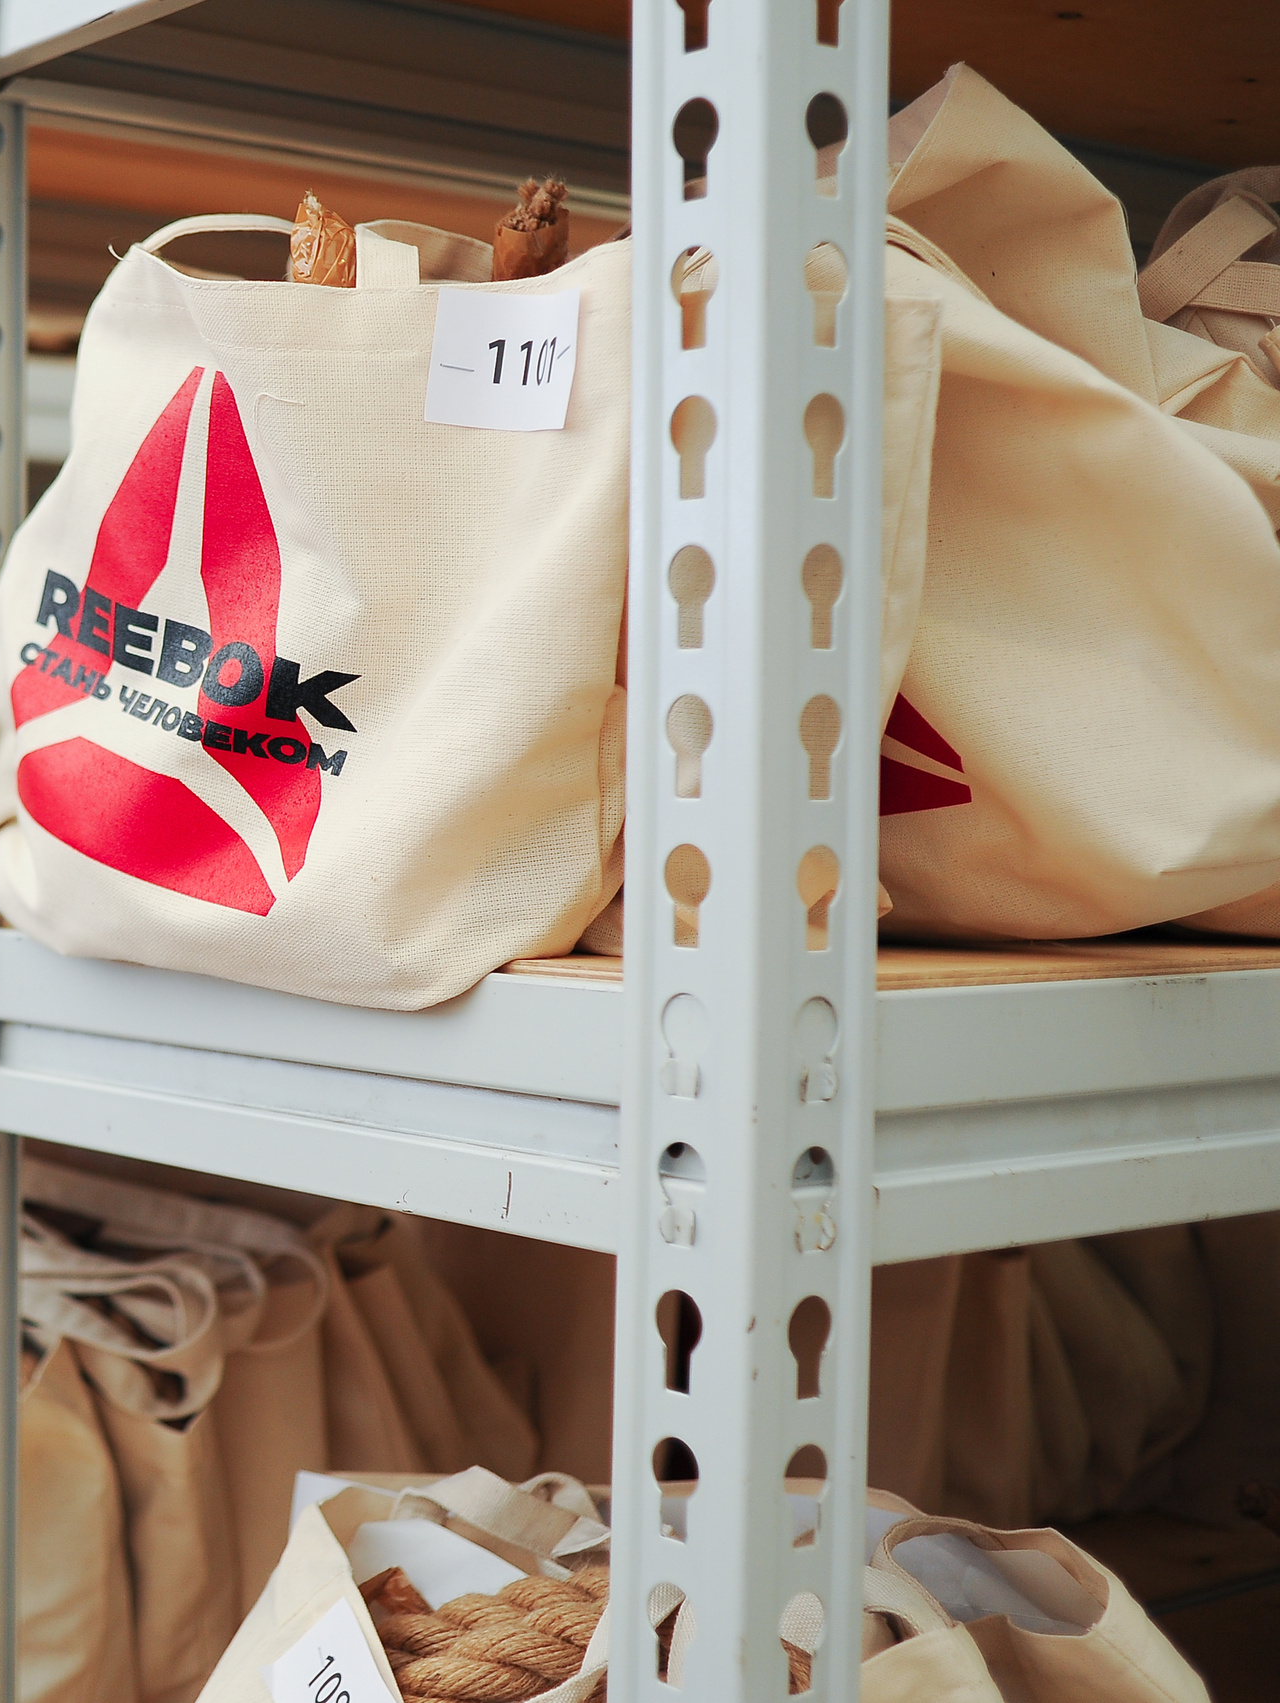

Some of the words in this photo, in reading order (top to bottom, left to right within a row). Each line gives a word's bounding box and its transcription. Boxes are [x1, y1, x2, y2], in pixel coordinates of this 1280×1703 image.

[488, 337, 557, 386] 1101
[20, 642, 111, 700] СТАНЬ
[119, 685, 348, 776] ЧЕЛОВЕКОМ
[37, 569, 362, 733] REEBOK
